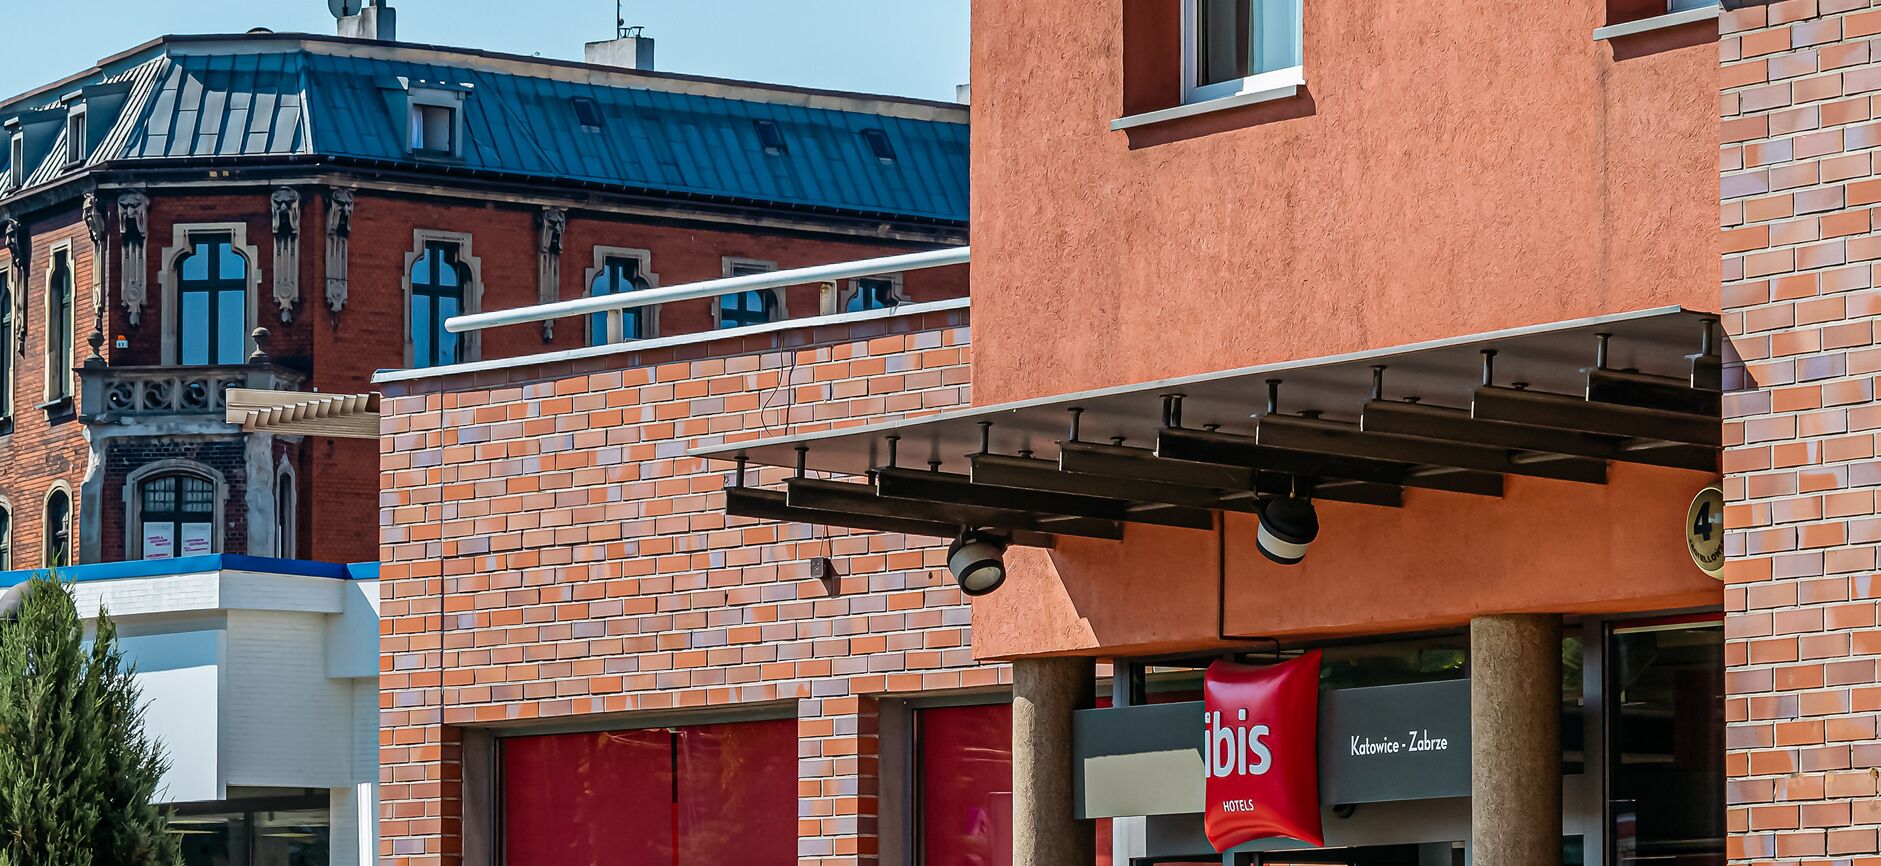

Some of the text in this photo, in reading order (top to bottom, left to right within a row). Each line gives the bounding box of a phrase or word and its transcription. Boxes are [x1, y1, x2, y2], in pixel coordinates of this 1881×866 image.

[1693, 501, 1712, 541] 4
[1205, 708, 1272, 778] ibis
[1350, 735, 1400, 756] Katowice
[1408, 729, 1448, 752] Zabrze
[1223, 799, 1254, 812] HOTELS
